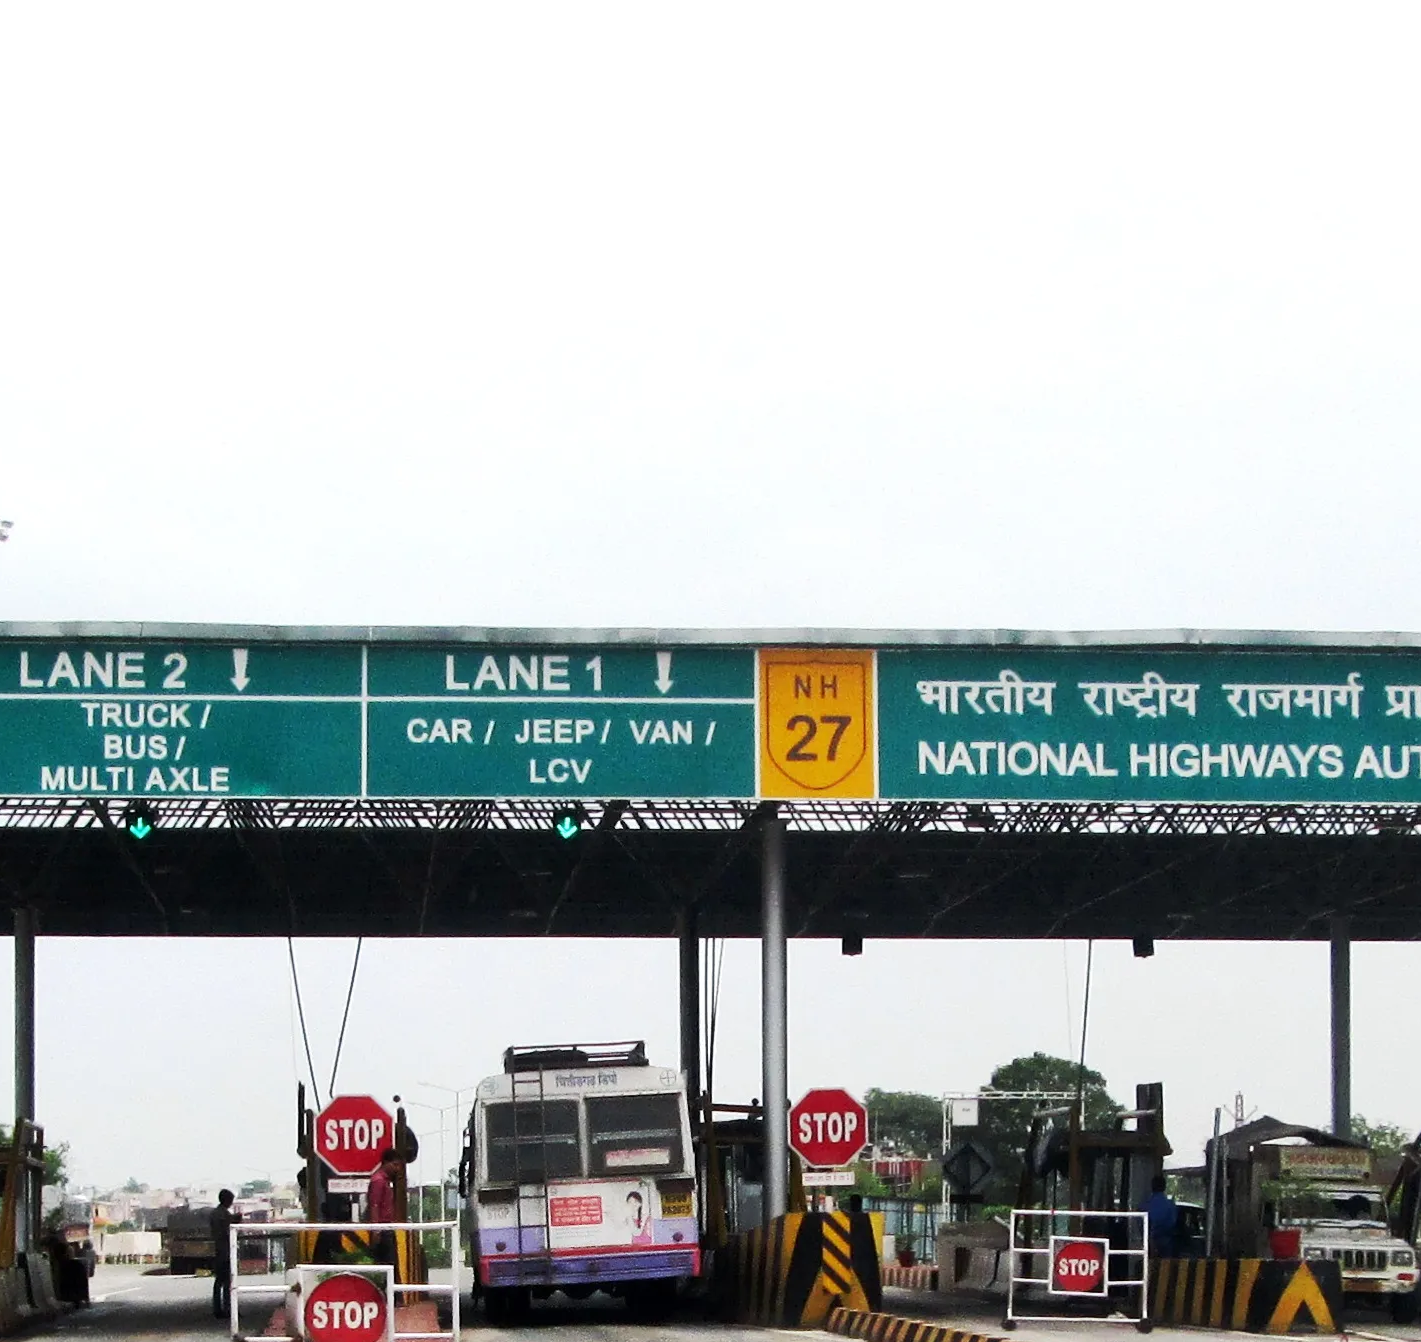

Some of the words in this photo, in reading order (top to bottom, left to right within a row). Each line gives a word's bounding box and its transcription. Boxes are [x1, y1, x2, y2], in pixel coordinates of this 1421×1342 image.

[20, 652, 145, 688] LANE
[163, 653, 187, 688] 2
[446, 656, 570, 690] LANE
[587, 657, 601, 690] 1
[795, 675, 837, 698] NH
[917, 670, 1056, 715] भारतीय
[1078, 672, 1200, 718] राष्ट्रीय
[1222, 673, 1363, 717] राजमार्ग
[82, 703, 193, 728] TRUCK
[407, 719, 472, 742] CAR
[630, 721, 692, 744] VAN
[787, 715, 851, 761] 27
[105, 735, 167, 759] BUS
[919, 741, 1118, 776] NATIONAL
[1130, 744, 1344, 778] HIGHWAYS
[42, 767, 133, 790] MULTI
[146, 768, 229, 792] AXLE
[530, 759, 592, 783] LCV
[326, 1119, 384, 1150] STOP
[800, 1112, 857, 1143] STOP
[1059, 1259, 1099, 1276] STOP
[313, 1301, 378, 1328] STOP
